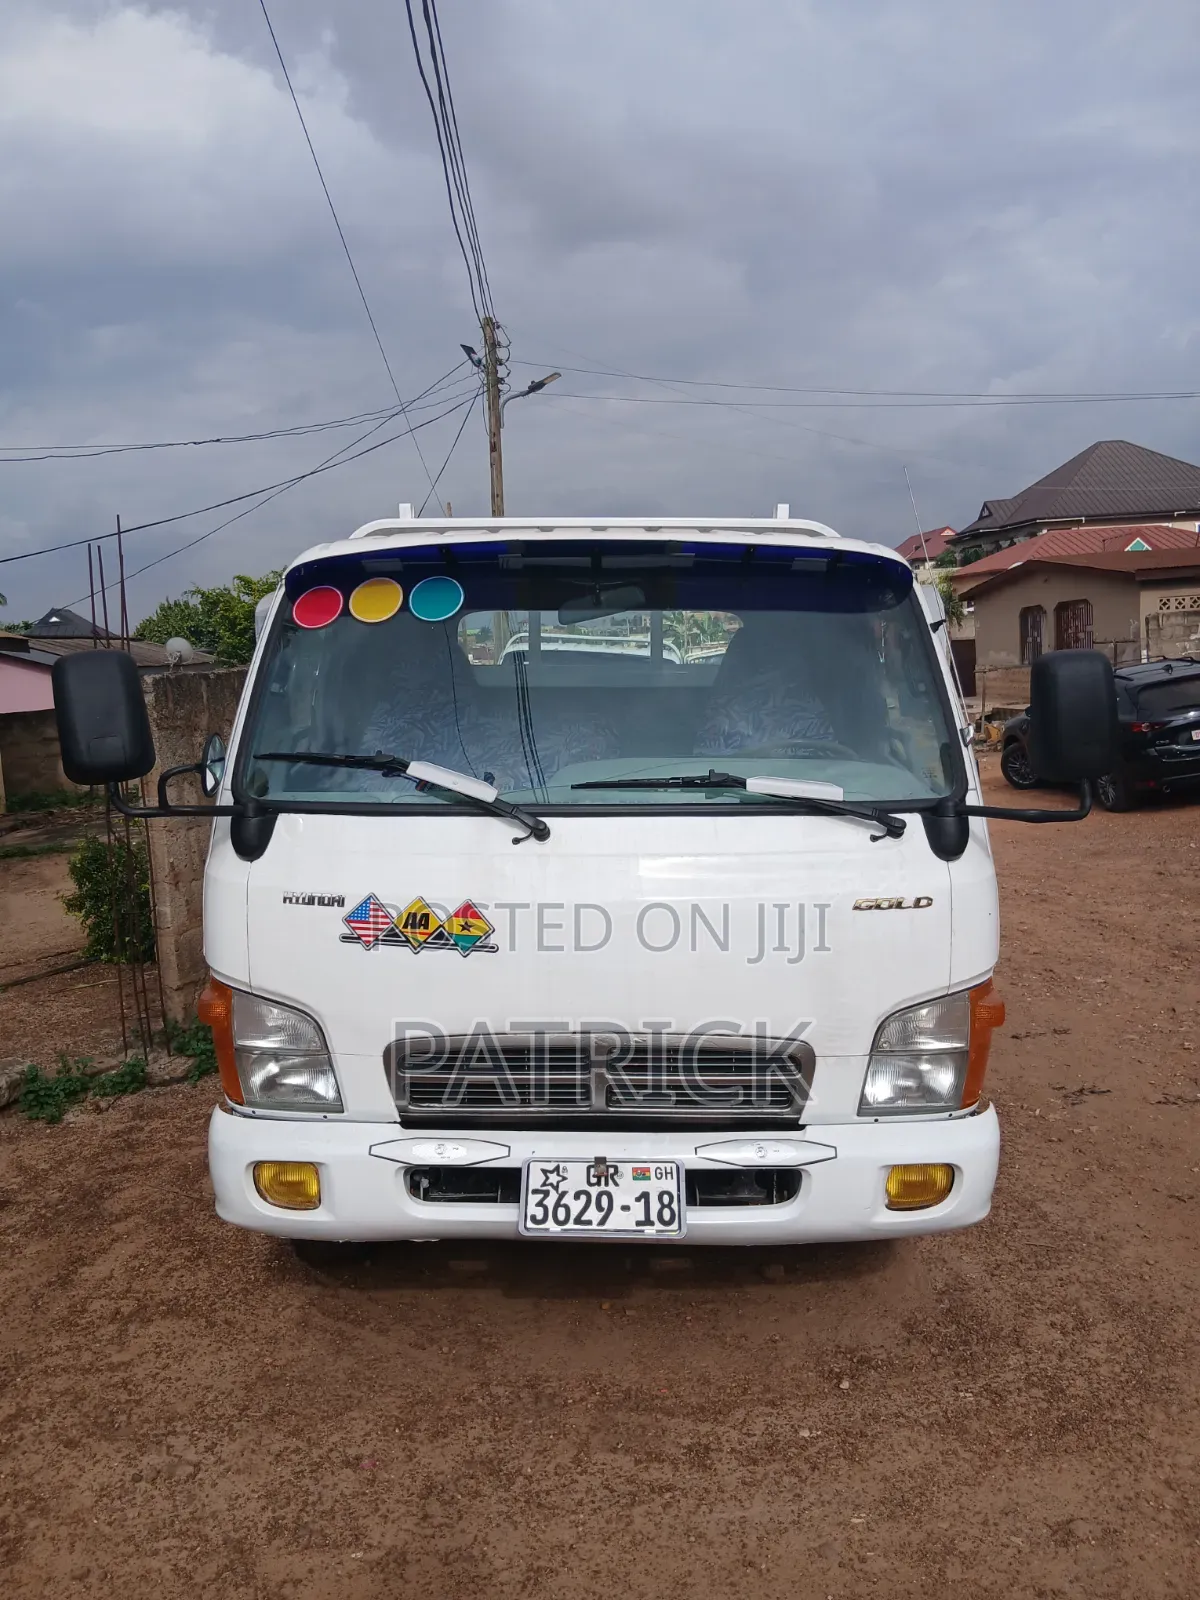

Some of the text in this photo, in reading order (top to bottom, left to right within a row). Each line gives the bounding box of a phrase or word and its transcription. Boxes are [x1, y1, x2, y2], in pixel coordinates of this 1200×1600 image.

[282, 891, 346, 908] HYUNDAI
[852, 896, 934, 911] GOLD
[402, 912, 430, 930] AA
[654, 1166, 674, 1181] GH
[529, 1188, 677, 1227] 3629-18
